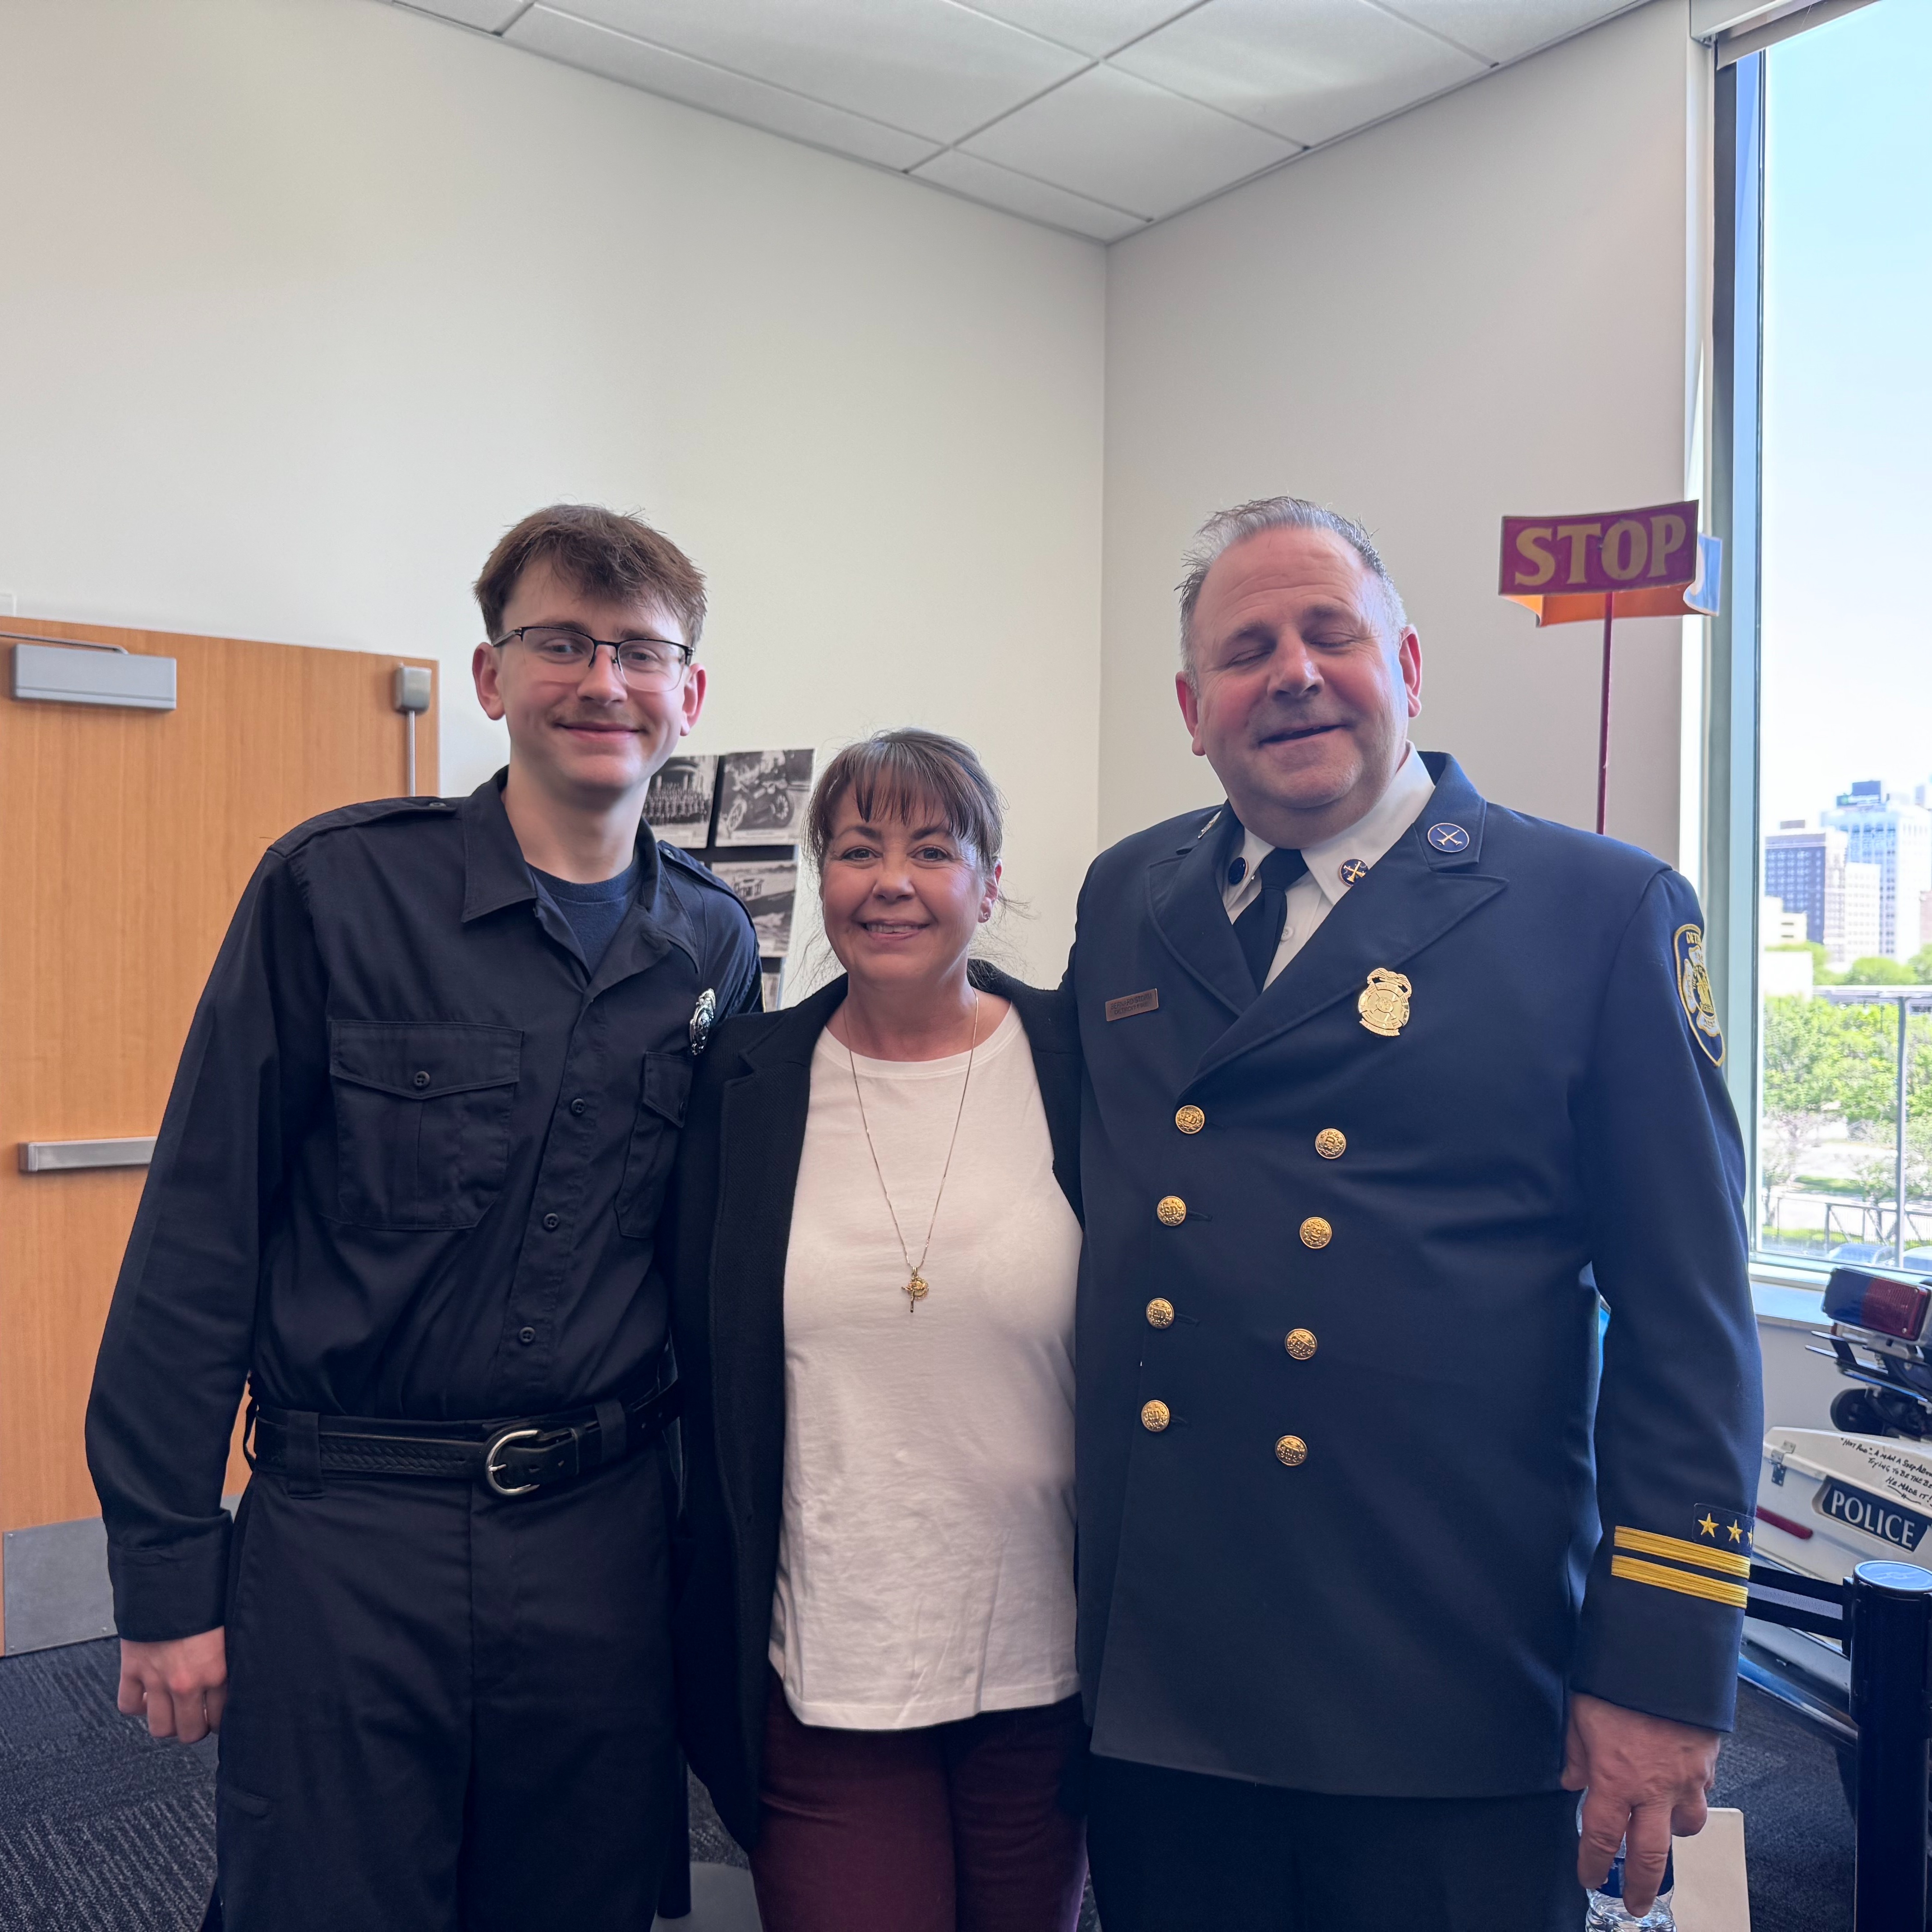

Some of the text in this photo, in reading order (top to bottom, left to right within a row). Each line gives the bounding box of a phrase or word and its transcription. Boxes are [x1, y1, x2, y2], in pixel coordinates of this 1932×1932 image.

[1514, 514, 1687, 586] STOP
[1880, 1454, 1896, 1462] MAN
[1900, 1470, 1910, 1479] BE
[1910, 1475, 1923, 1484] THE
[1898, 1482, 1918, 1496] MADE
[1831, 1490, 1915, 1548] POLICE
